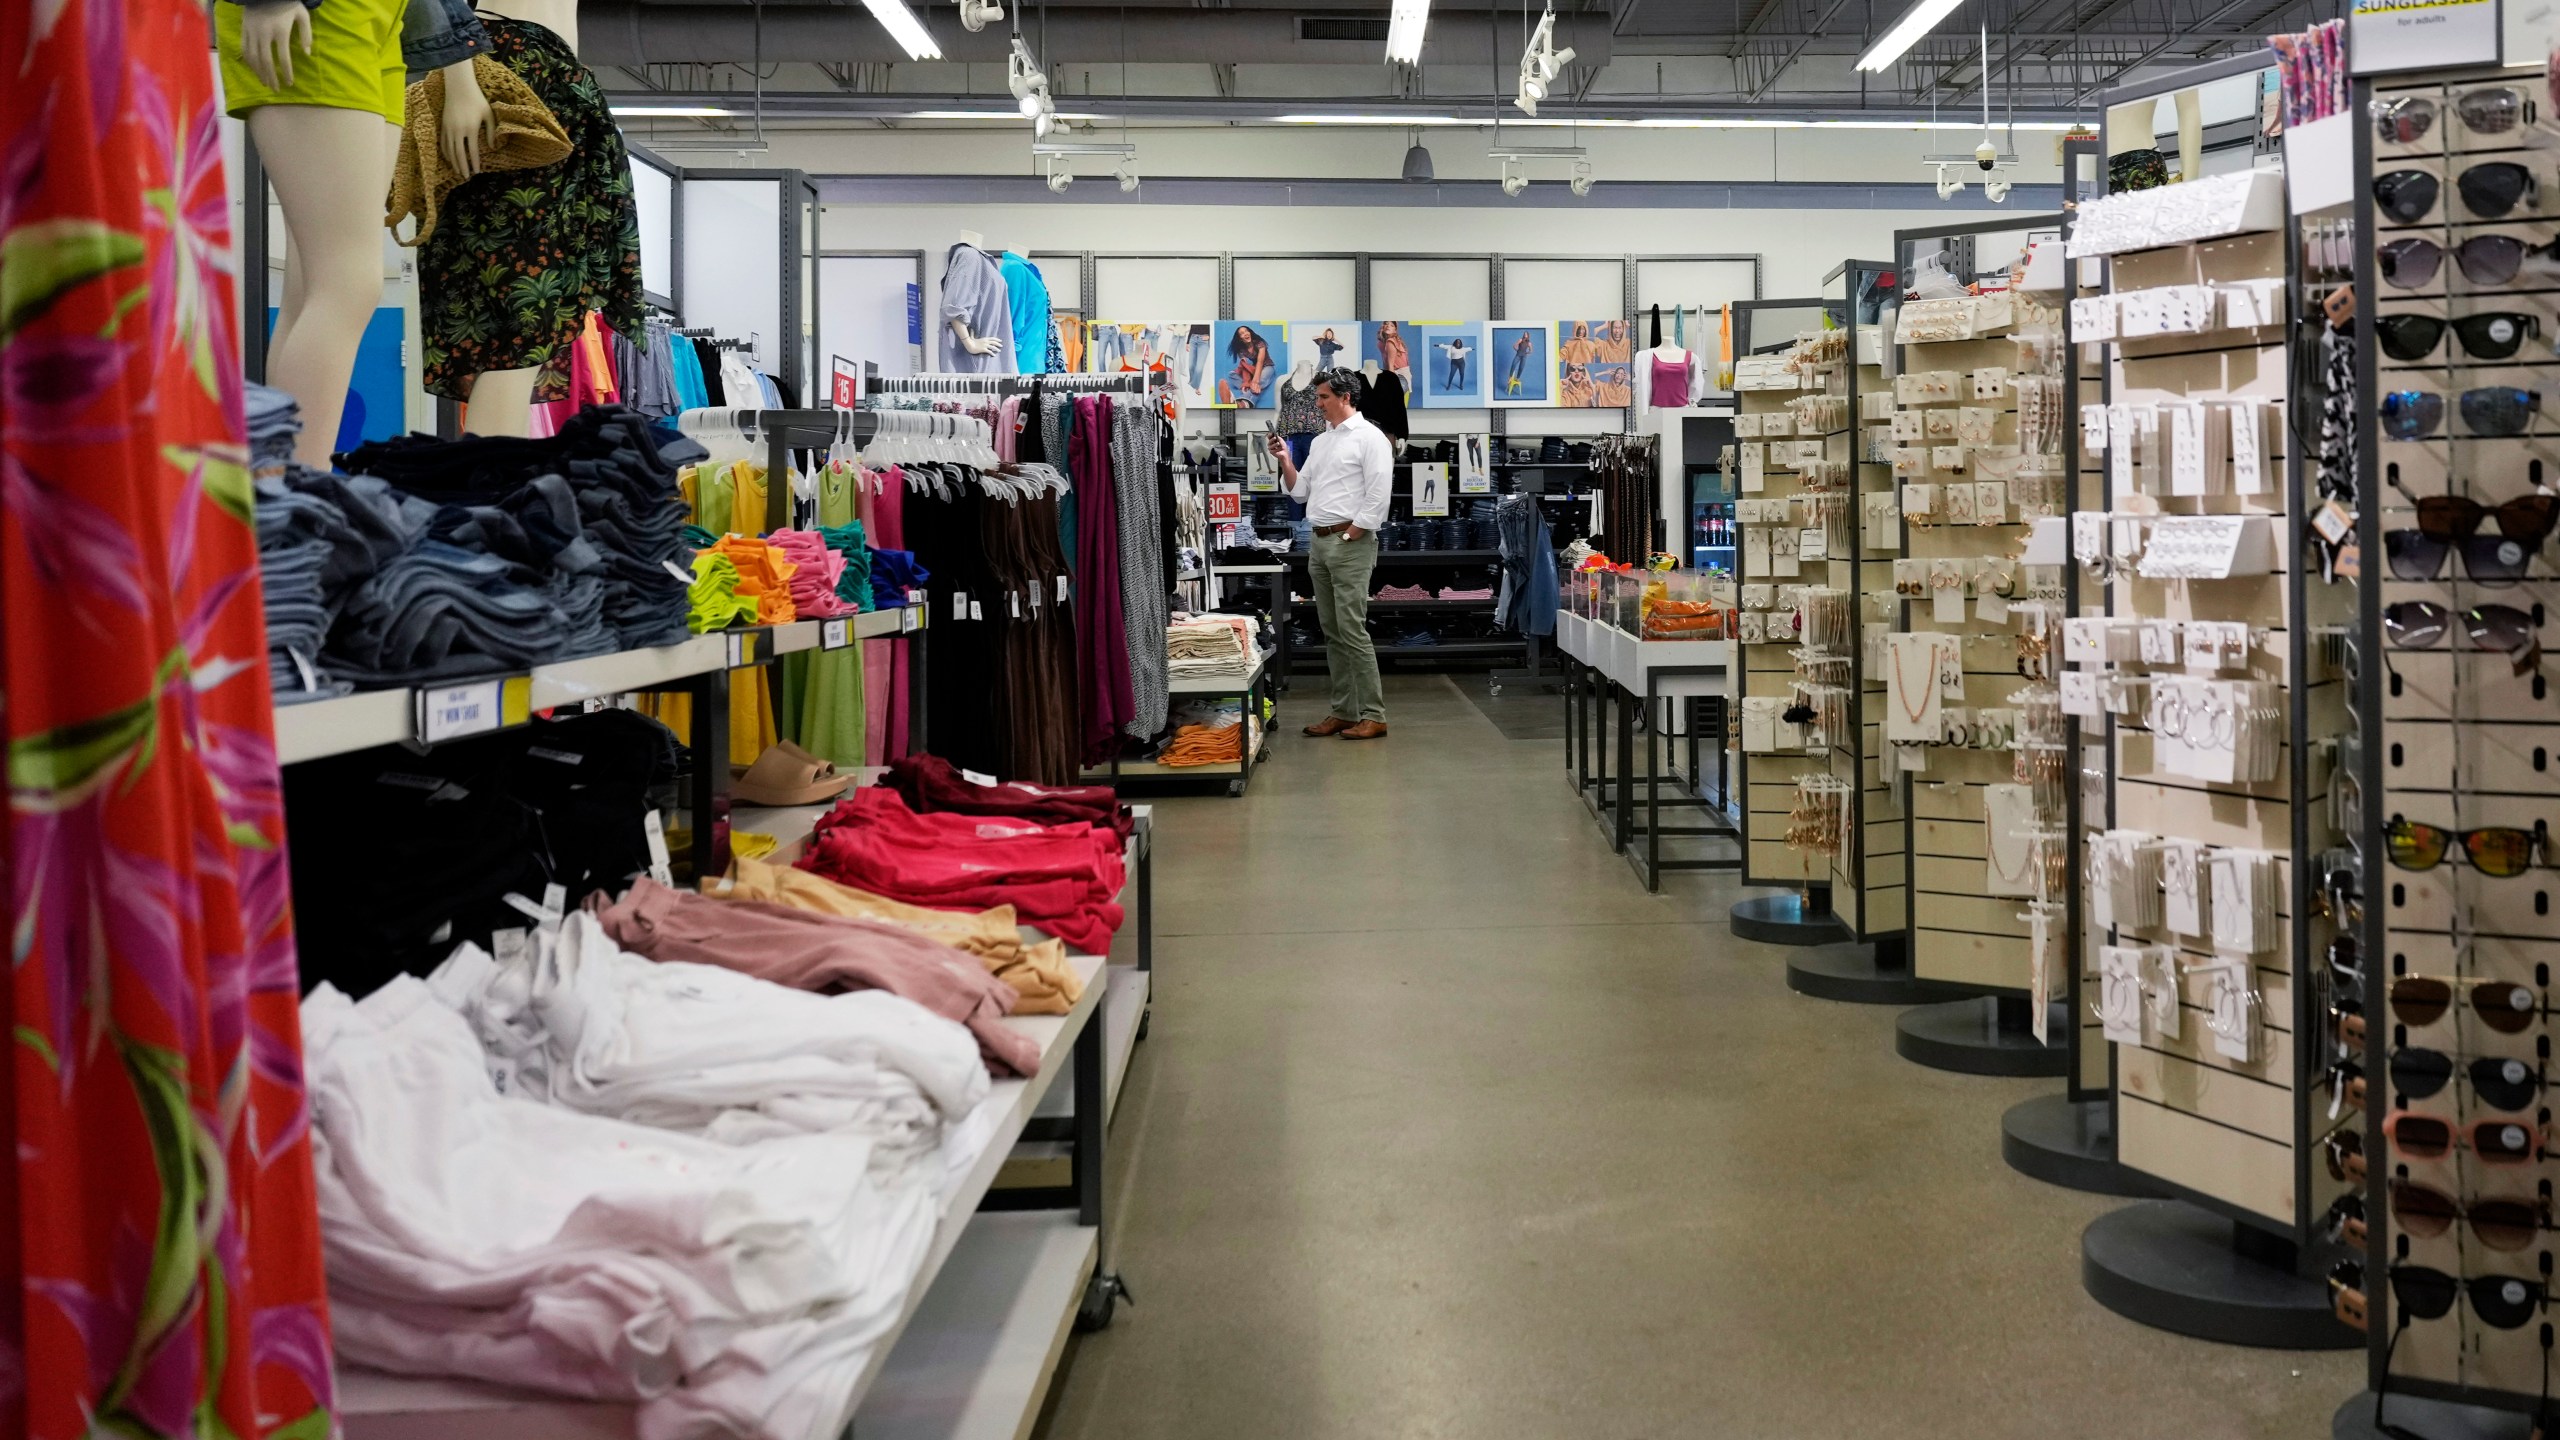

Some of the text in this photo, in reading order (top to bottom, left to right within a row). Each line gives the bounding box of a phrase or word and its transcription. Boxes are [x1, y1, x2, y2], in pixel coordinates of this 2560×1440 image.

[2359, 0, 2483, 13] SUNGL
[2398, 15, 2446, 26] for adults
[837, 377, 850, 404] $15
[1225, 507, 1235, 515] OFF
